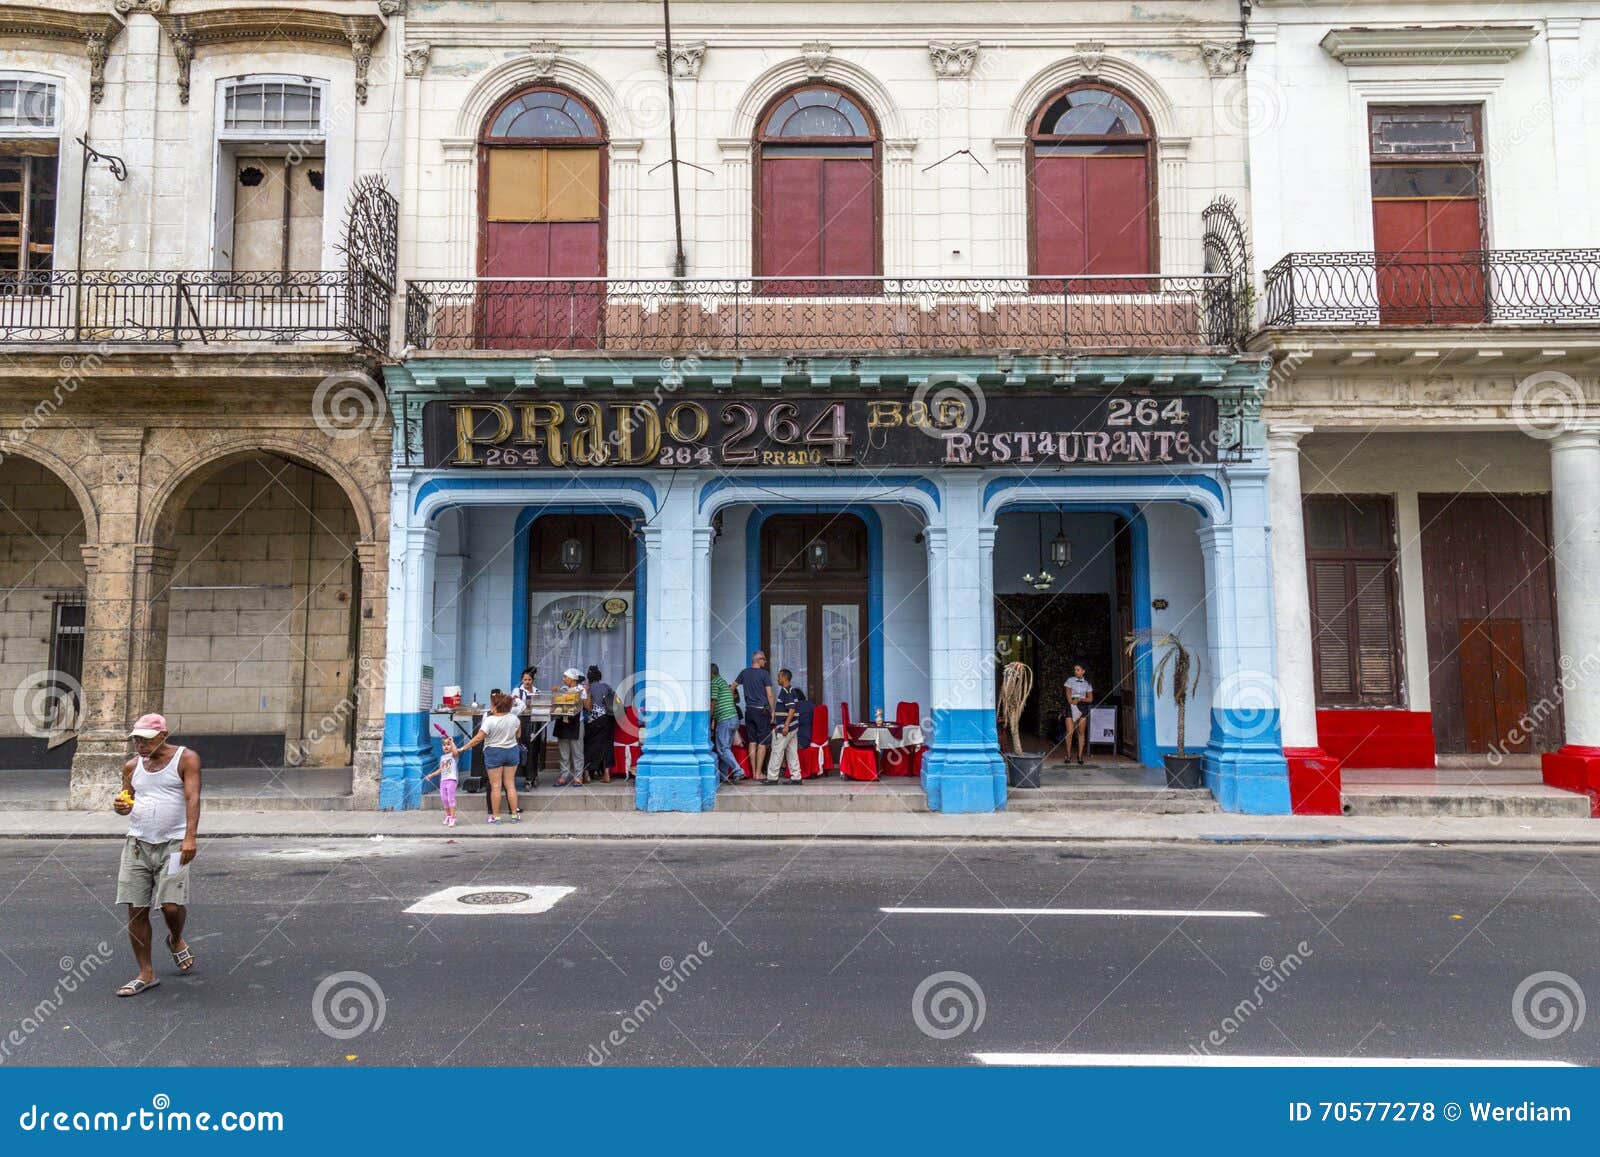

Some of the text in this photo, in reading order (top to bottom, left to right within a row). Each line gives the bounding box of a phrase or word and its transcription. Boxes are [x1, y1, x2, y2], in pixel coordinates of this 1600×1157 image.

[1107, 398, 1190, 426] 264
[720, 402, 854, 466] 264
[486, 448, 540, 466] 264
[660, 446, 713, 465] 264
